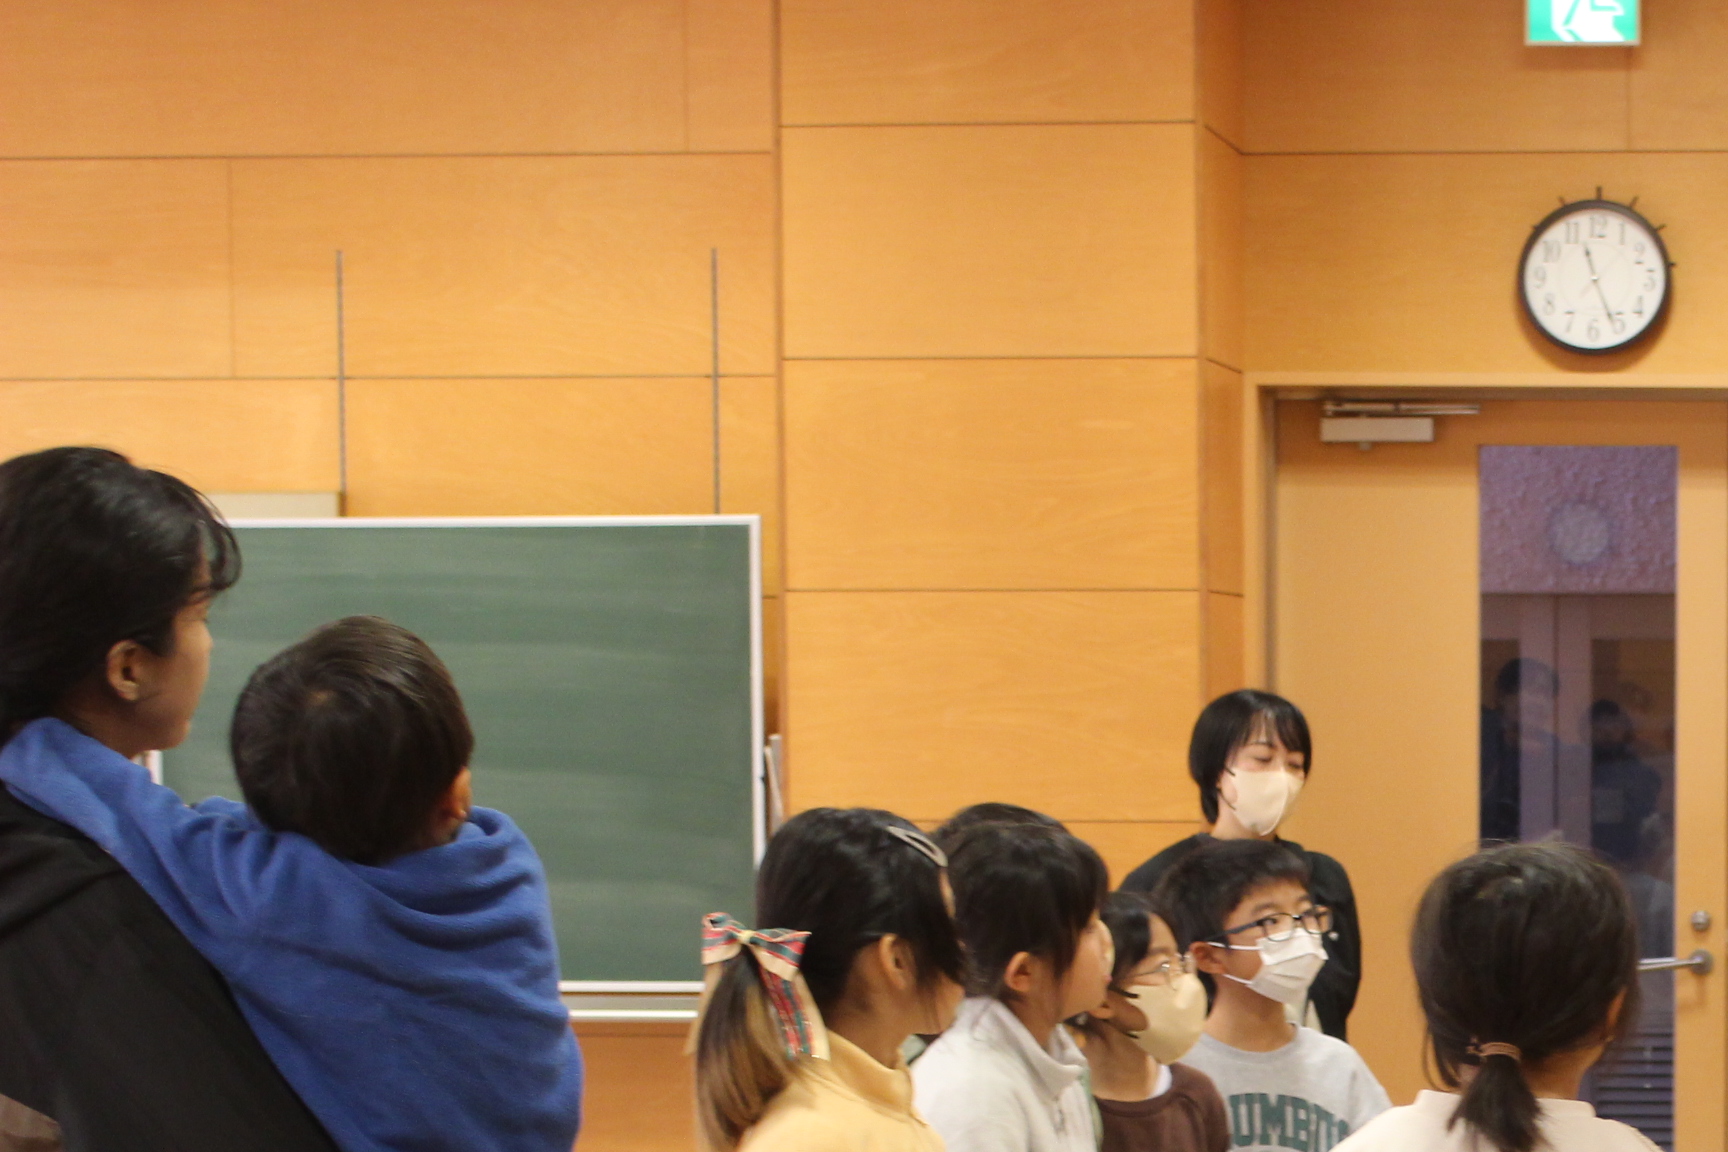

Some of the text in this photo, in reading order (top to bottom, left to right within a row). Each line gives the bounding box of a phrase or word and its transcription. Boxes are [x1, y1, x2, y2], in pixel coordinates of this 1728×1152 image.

[1565, 221, 1579, 244] 11
[1590, 214, 1608, 238] 12
[1543, 240, 1561, 263] 10
[1634, 241, 1645, 265] 2
[1533, 265, 1547, 289] 9
[1643, 267, 1656, 291] 3
[1543, 292, 1556, 316] 8
[1632, 295, 1643, 318] 4
[1564, 310, 1575, 333] 7
[1587, 318, 1600, 343] 6
[1614, 311, 1626, 335] 5
